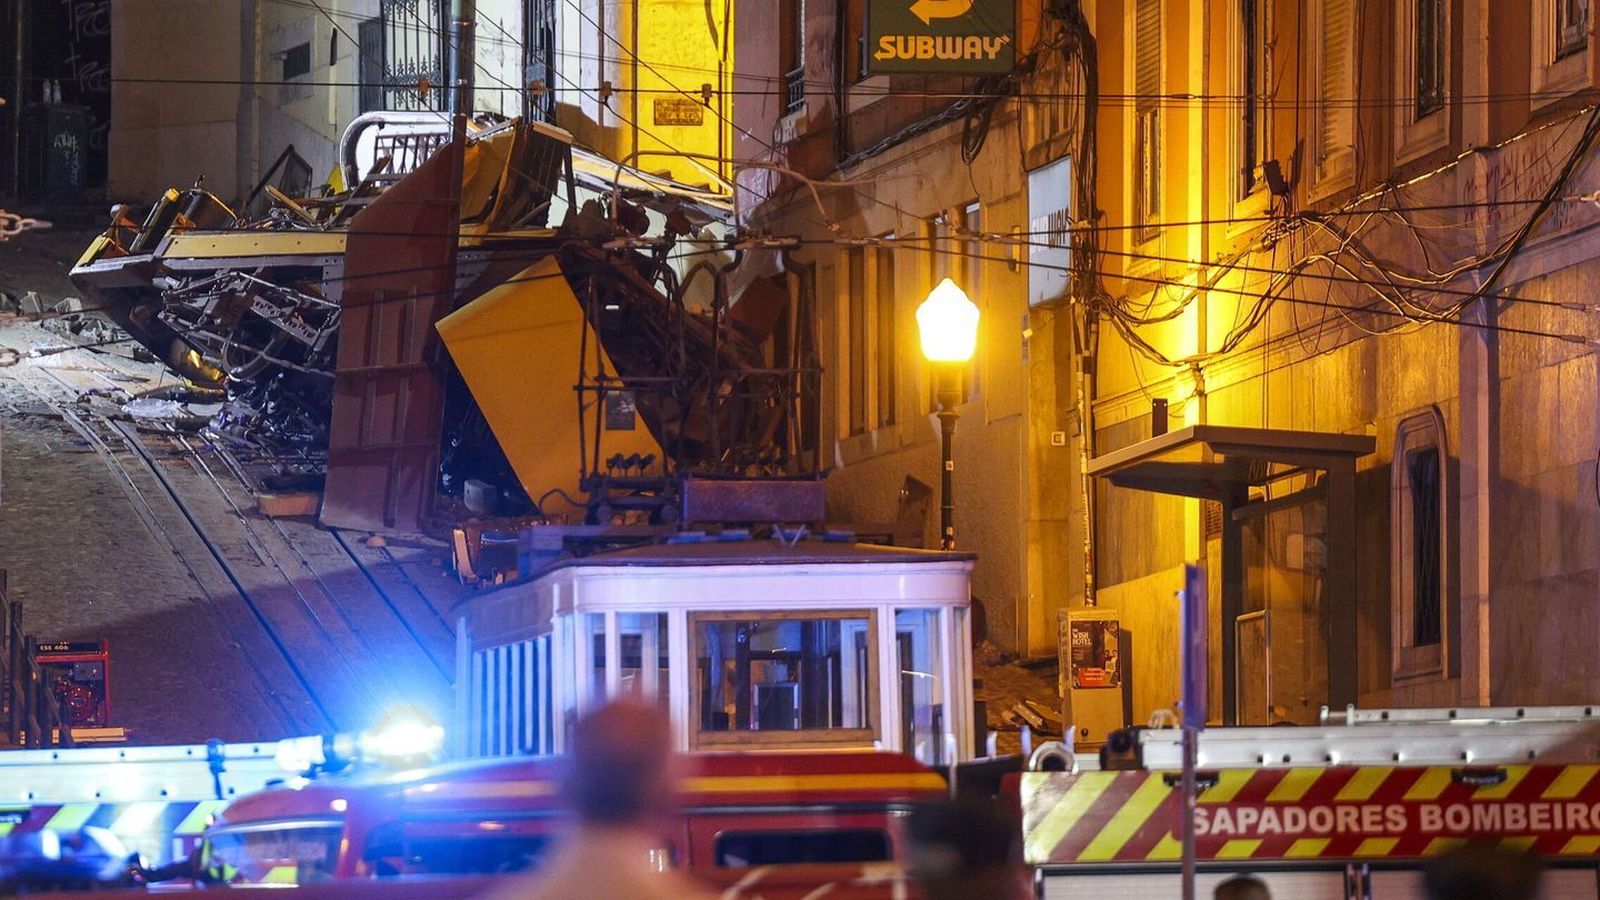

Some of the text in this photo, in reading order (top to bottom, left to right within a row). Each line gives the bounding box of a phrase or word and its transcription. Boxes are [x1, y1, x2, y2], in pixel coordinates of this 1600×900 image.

[873, 35, 1010, 61] SUBWAY
[1072, 631, 1089, 639] WISH
[1072, 638, 1092, 646] HOTEL
[1193, 804, 1408, 834] SAPADORES
